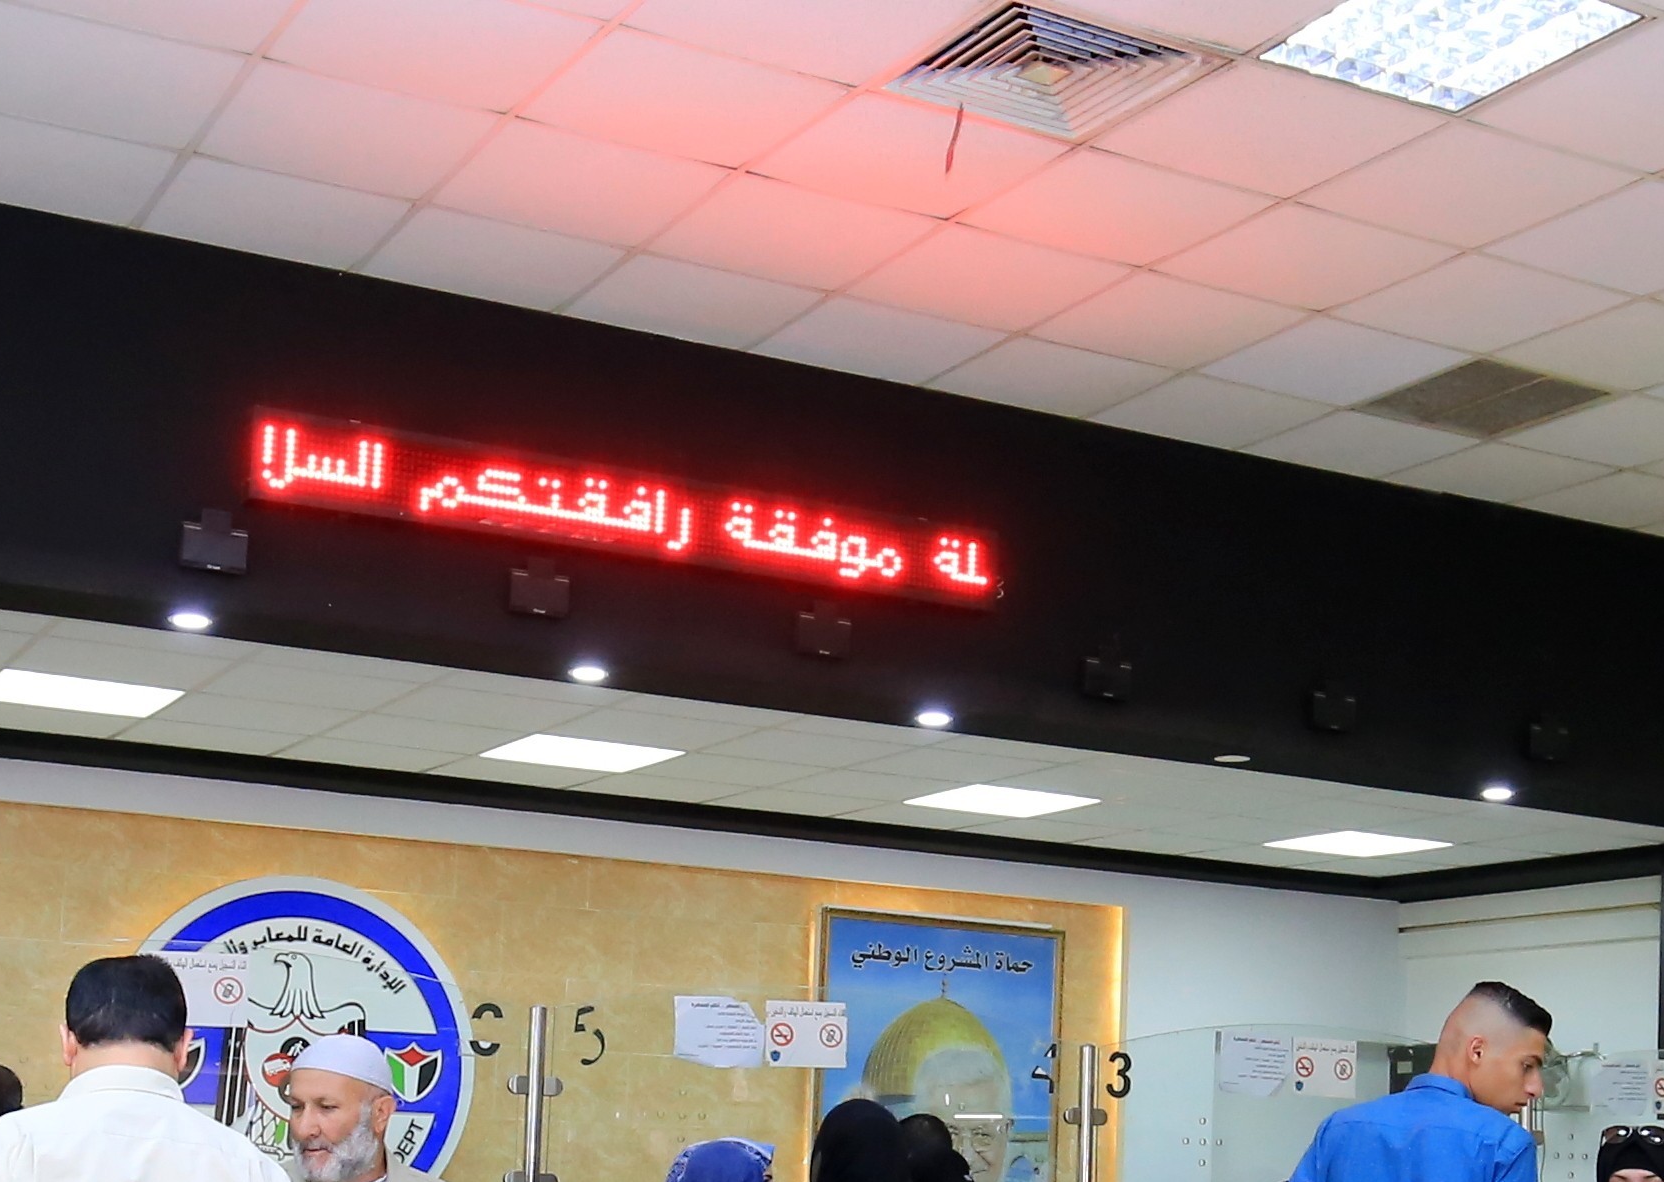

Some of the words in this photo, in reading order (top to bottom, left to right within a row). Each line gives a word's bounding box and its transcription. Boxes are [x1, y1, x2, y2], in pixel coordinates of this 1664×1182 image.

[419, 467, 692, 552] رافقتكم
[724, 501, 903, 579] موفقة
[251, 925, 308, 949] للمعابر
[312, 928, 365, 959] العامة
[851, 941, 919, 969] الوطني
[923, 945, 989, 972] المشروع
[993, 951, 1034, 974] حماة
[574, 1006, 605, 1066] 5
[1106, 1051, 1132, 1099] 3
